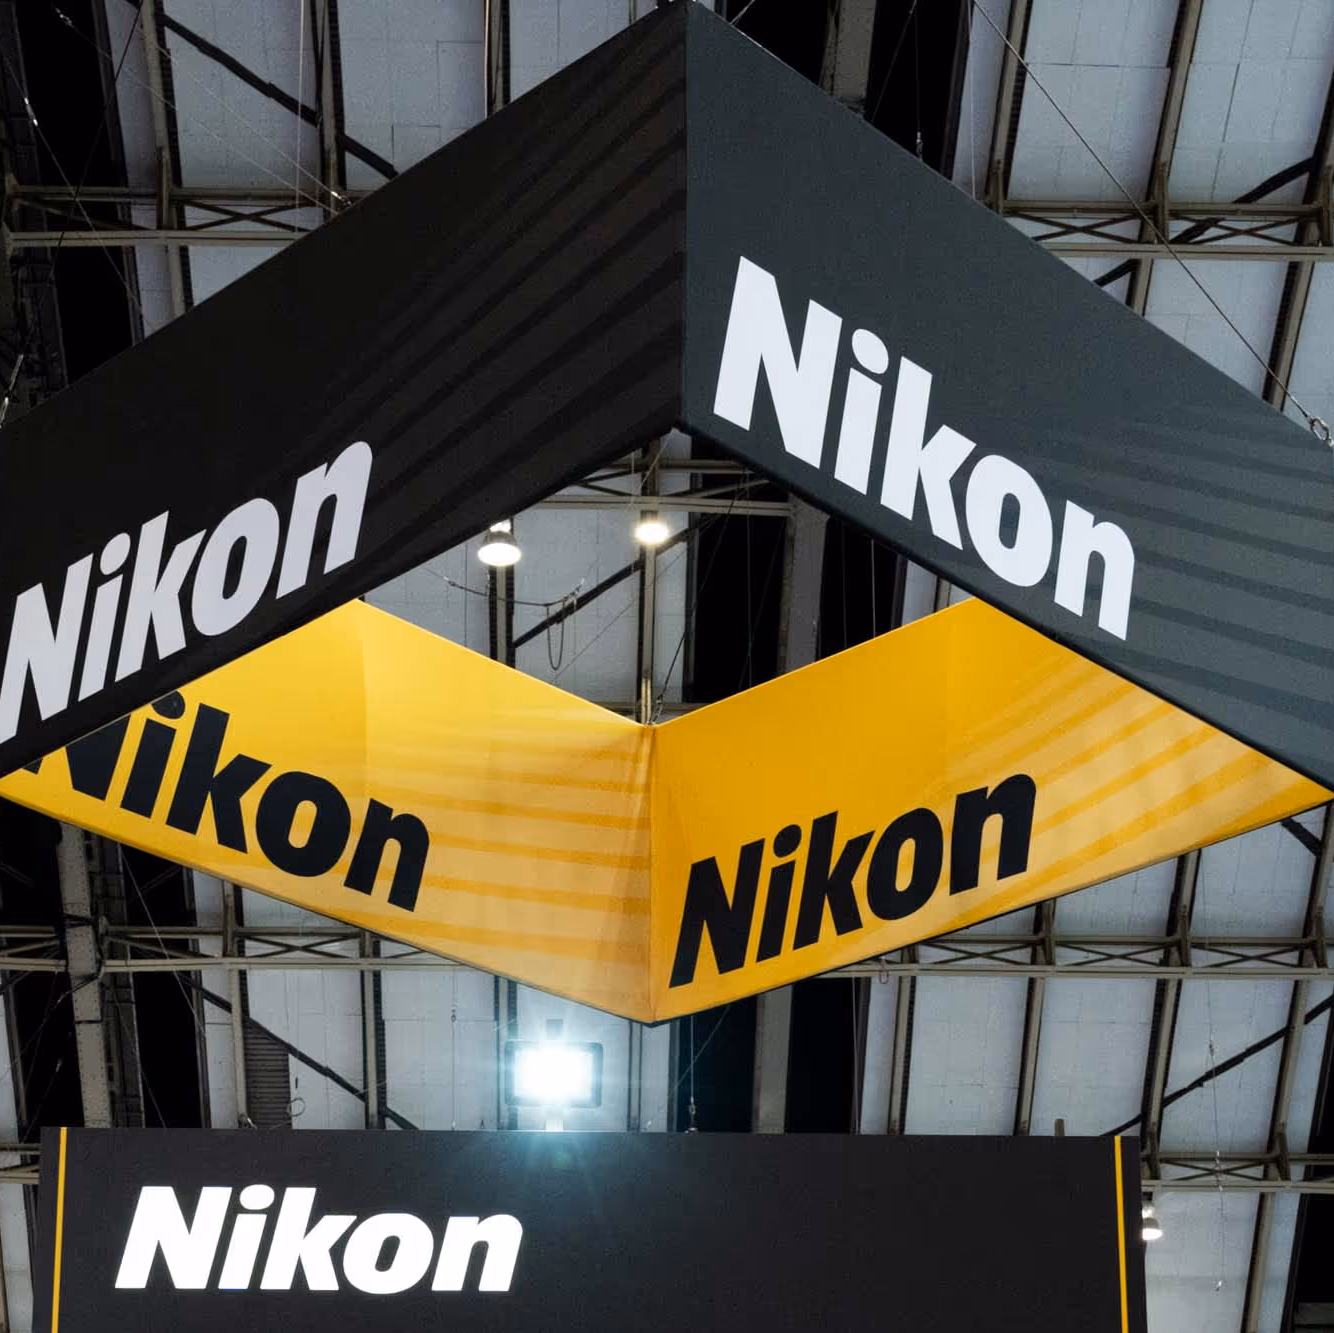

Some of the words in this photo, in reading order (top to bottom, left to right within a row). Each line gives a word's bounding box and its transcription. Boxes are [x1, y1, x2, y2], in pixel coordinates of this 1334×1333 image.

[714, 256, 1134, 640] Nikon
[670, 775, 1036, 987] Nikon
[115, 1185, 523, 1294] Nikon
